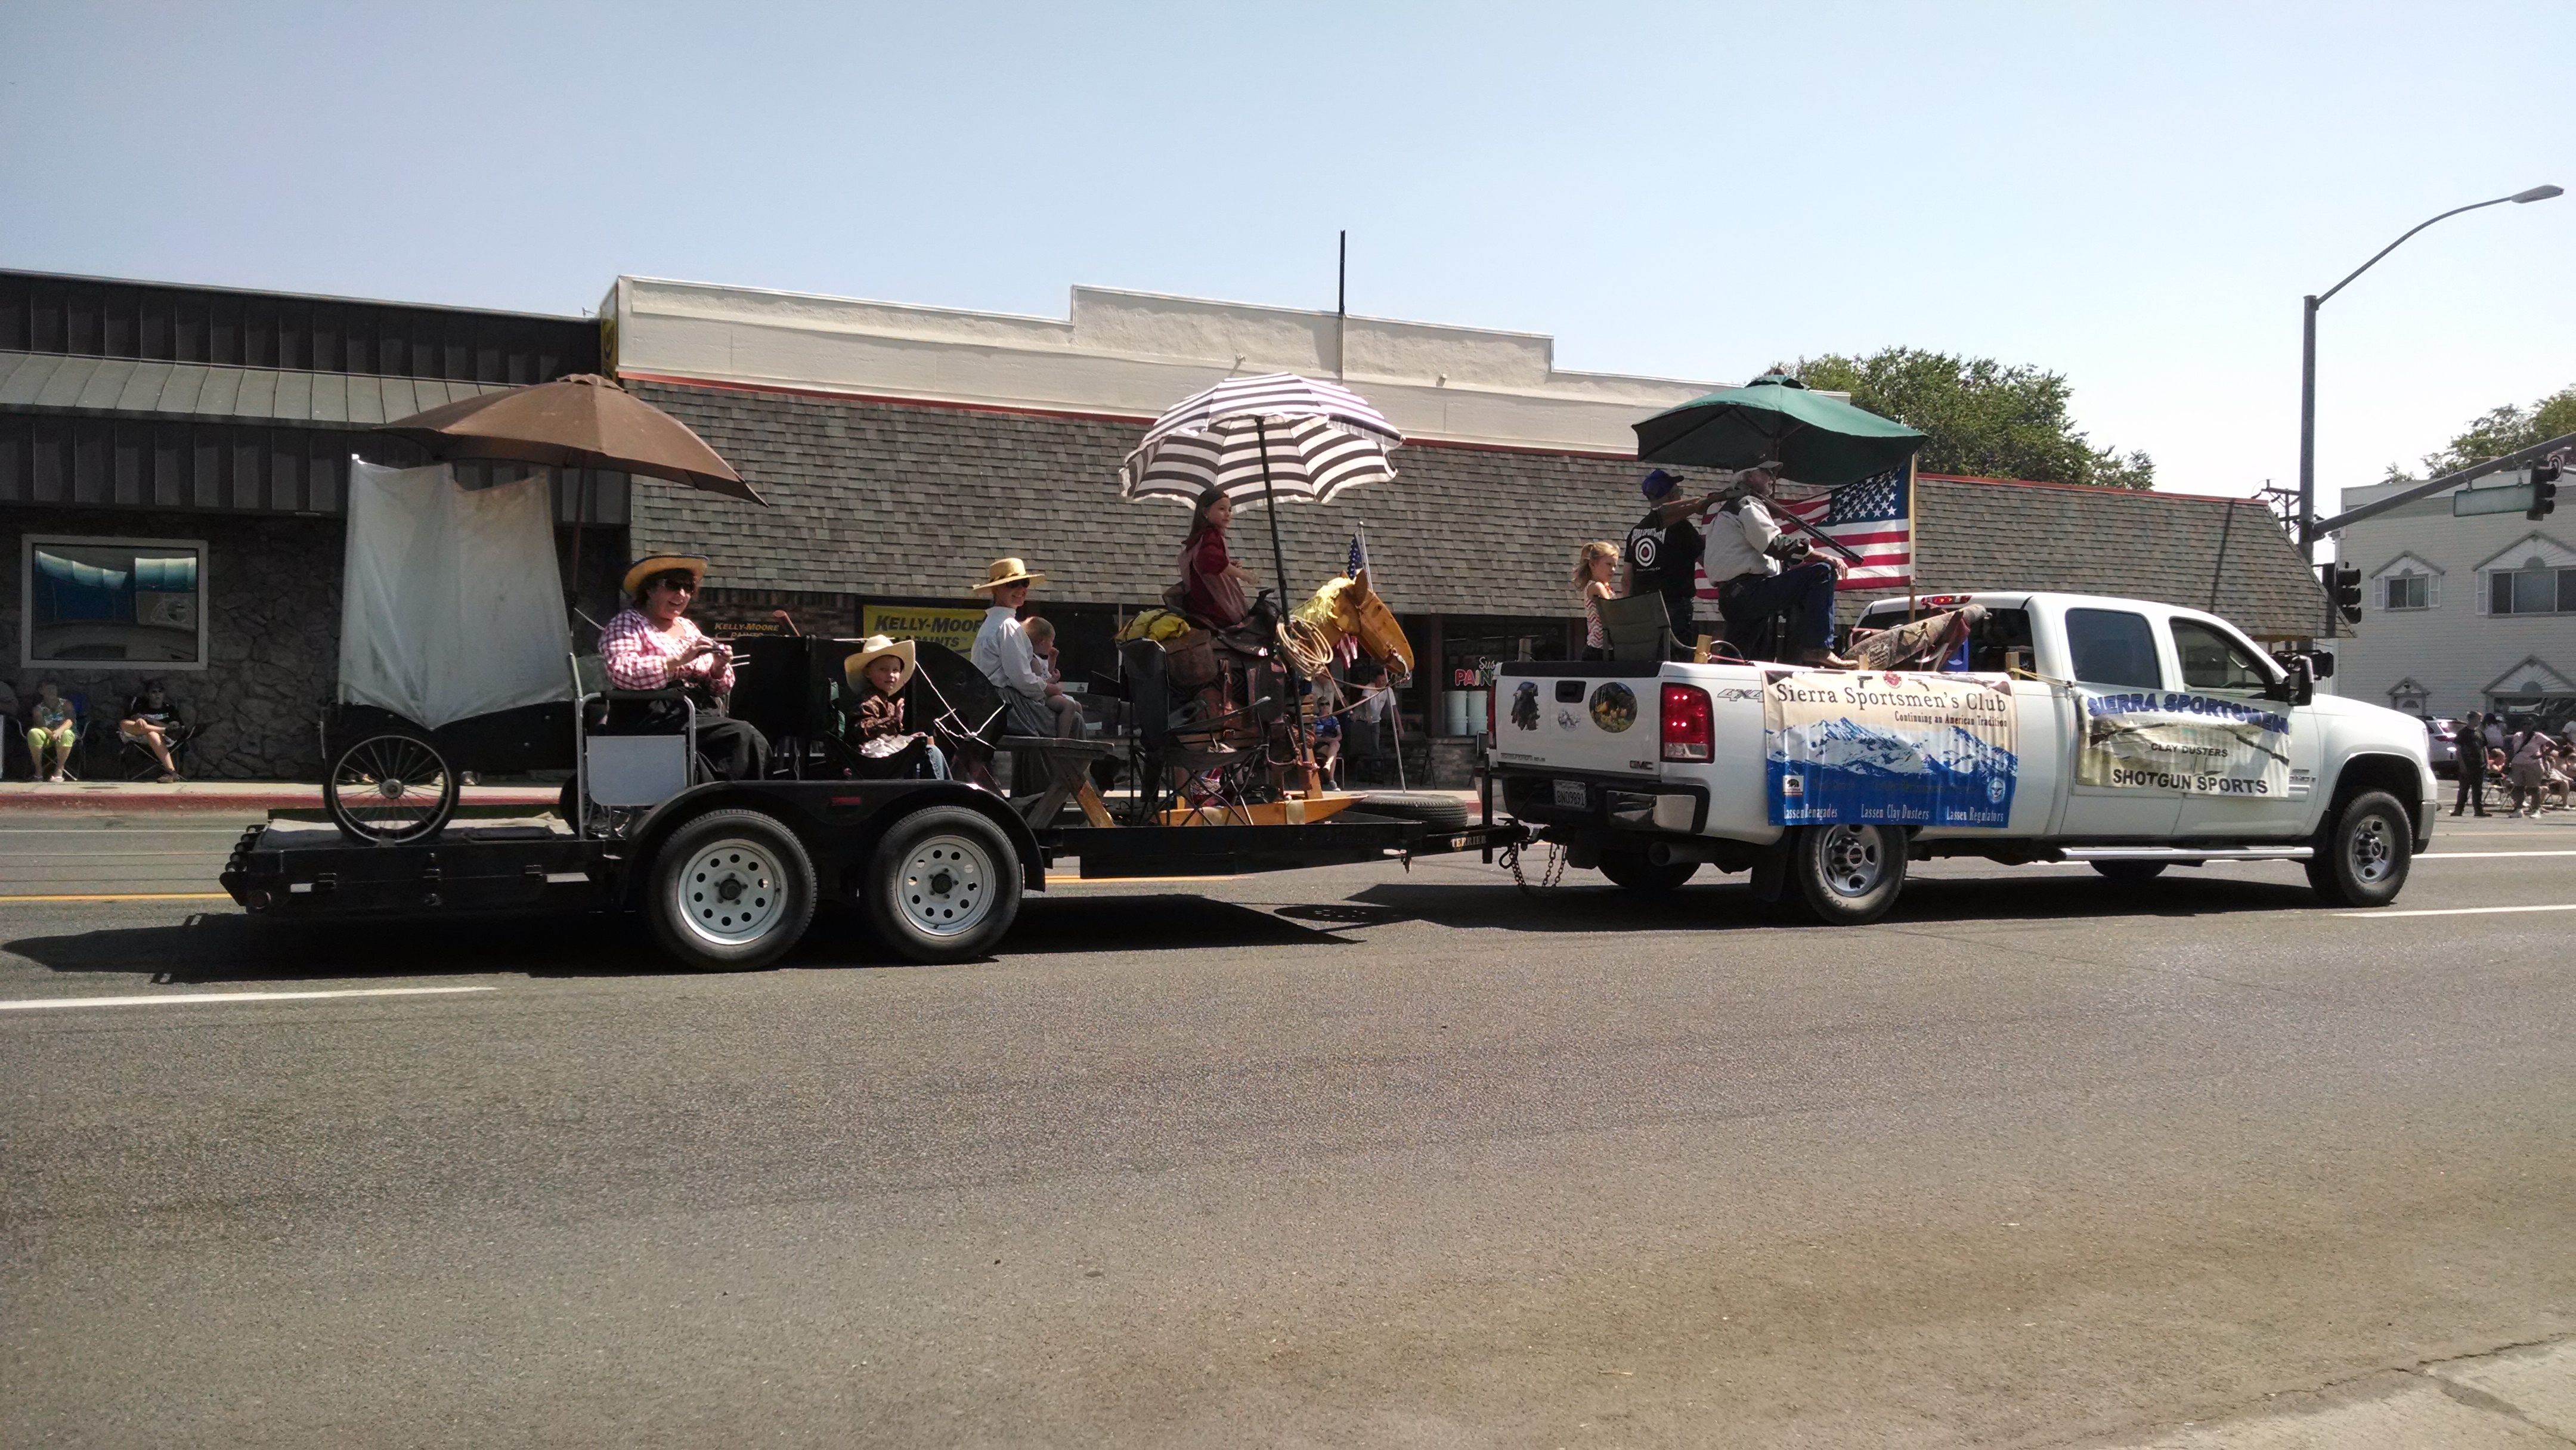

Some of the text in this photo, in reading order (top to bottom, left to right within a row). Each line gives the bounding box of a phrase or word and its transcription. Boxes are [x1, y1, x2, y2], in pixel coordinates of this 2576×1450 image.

[714, 622, 780, 631] KELLY-MOORE
[874, 615, 984, 633] KELLY-MOOR
[1479, 656, 1500, 670] Sus
[1455, 668, 1495, 686] PAIN
[1776, 684, 2006, 712] Sierra Sportsmen's Club
[1894, 711, 2007, 727] Continuing an American Tradition
[2088, 693, 2289, 735] SIERRA SPORTSMEN
[2151, 742, 2228, 758] CLAY DUSTERS
[1629, 760, 1654, 770] GMC
[2113, 769, 2268, 794] SHOTGUN SPORTS
[1860, 804, 1929, 822] Lassen Clay Dusters
[1946, 805, 2004, 823] Lassen Regulators
[1450, 835, 1487, 848] TERRIER
